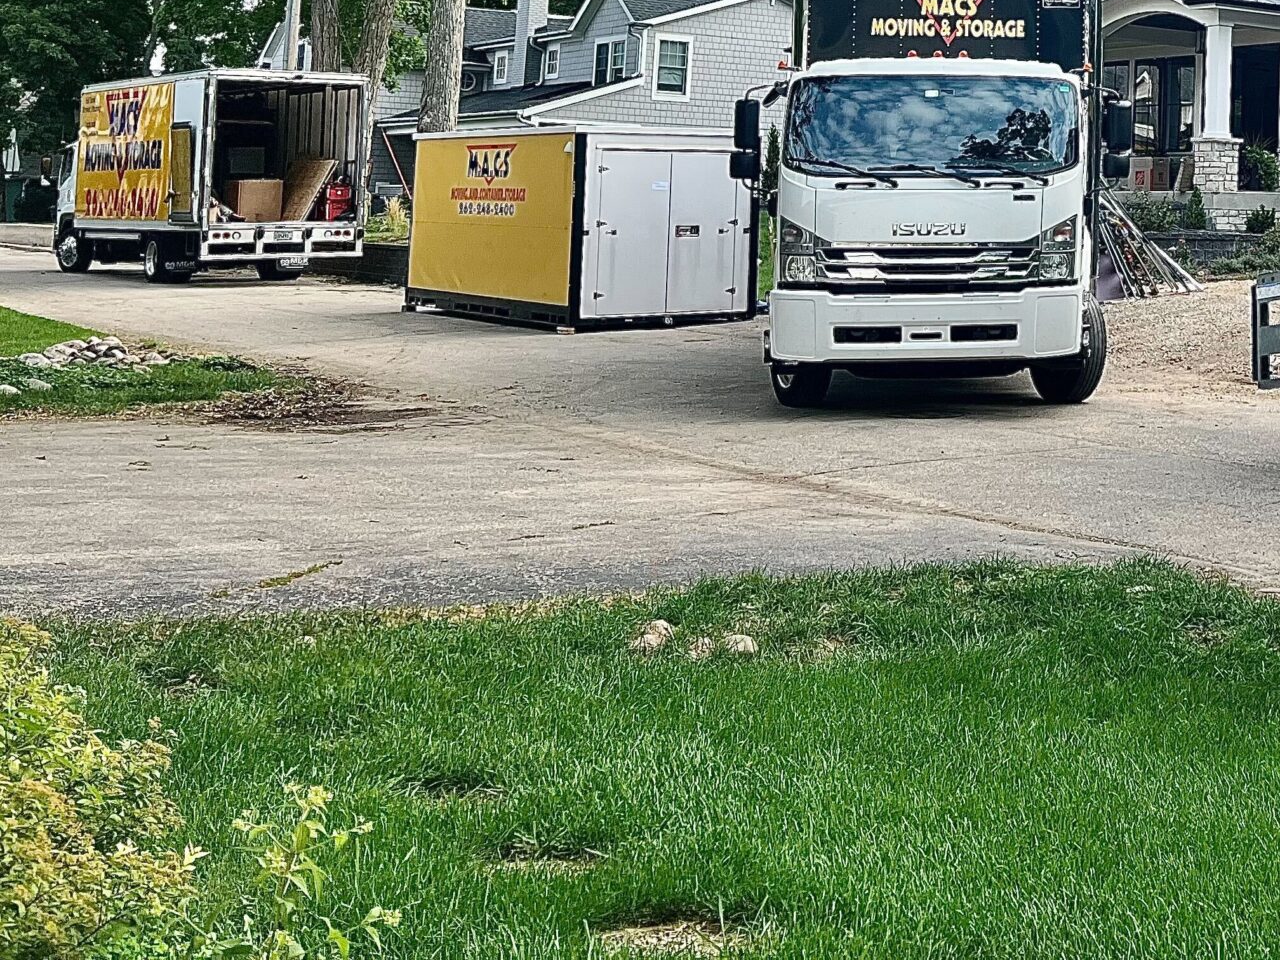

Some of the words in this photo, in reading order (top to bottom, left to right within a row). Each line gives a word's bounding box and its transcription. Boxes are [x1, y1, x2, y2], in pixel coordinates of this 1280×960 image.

[870, 17, 936, 37] MOVING
[940, 18, 952, 38] &
[955, 19, 1026, 38] STORAGE
[458, 201, 515, 216] 262-248-2400
[891, 222, 967, 237] ISUZU
